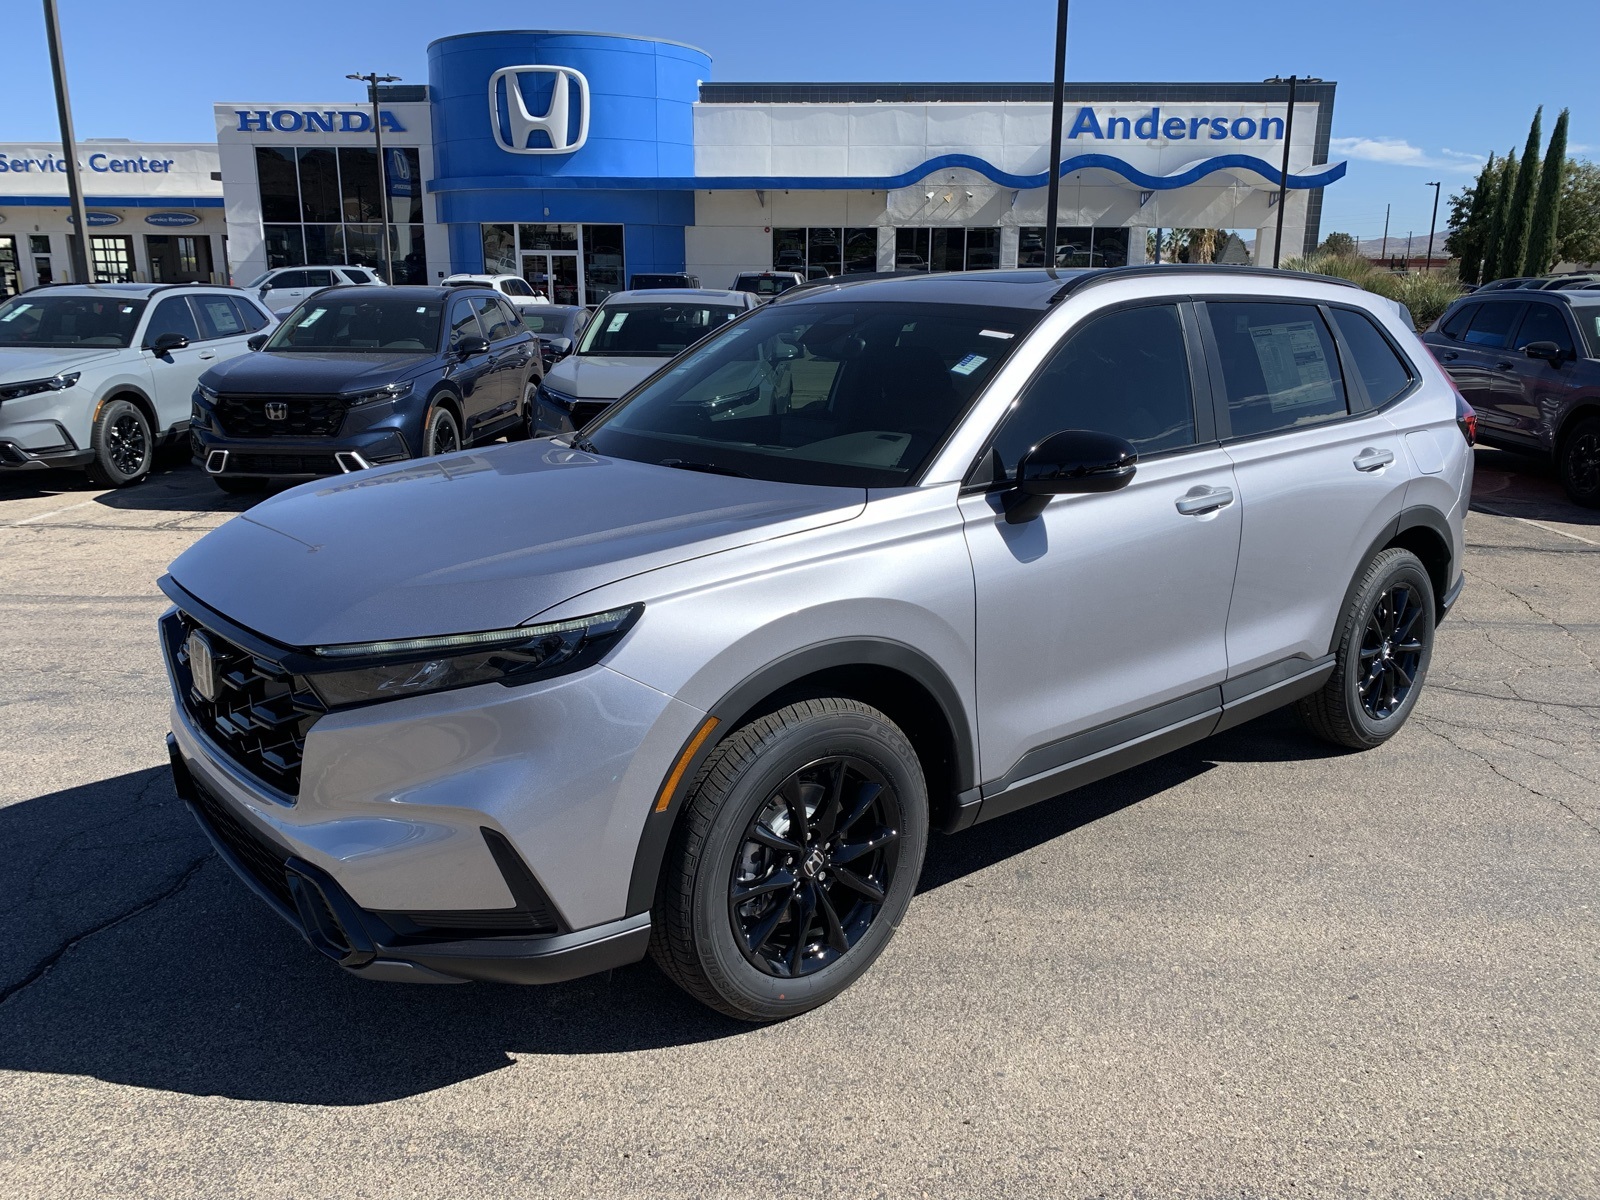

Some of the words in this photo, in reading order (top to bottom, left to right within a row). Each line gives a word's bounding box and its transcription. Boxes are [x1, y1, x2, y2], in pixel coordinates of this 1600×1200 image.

[234, 110, 408, 132] HONDA
[1068, 107, 1285, 140] Anderson
[0, 153, 82, 173] Servic
[89, 153, 174, 173] Center
[540, 234, 589, 242] WELCOE
